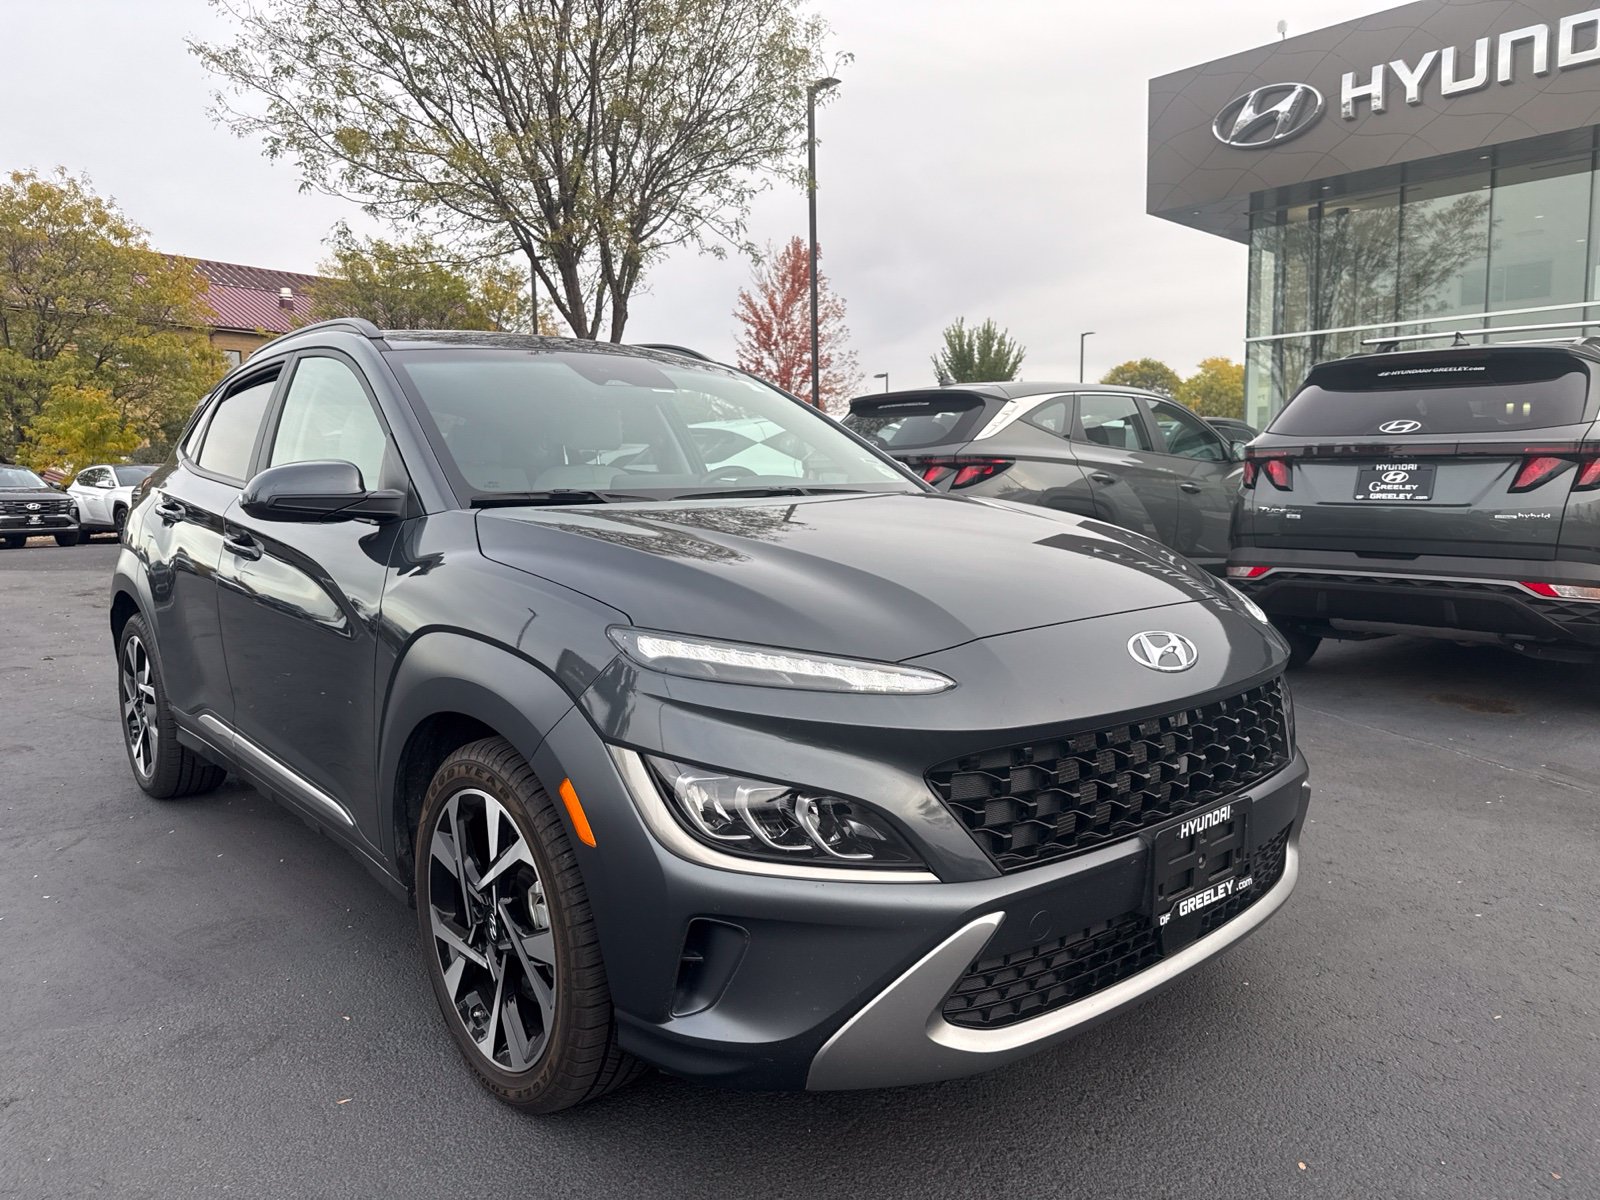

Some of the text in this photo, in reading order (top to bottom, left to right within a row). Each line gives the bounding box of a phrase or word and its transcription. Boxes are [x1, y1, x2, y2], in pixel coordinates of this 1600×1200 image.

[1375, 463, 1418, 471] HYUNDAI
[1369, 492, 1413, 500] GREELEY
[1180, 805, 1231, 839] HYUNDAI
[1159, 877, 1253, 926] OF GREELEY .com
